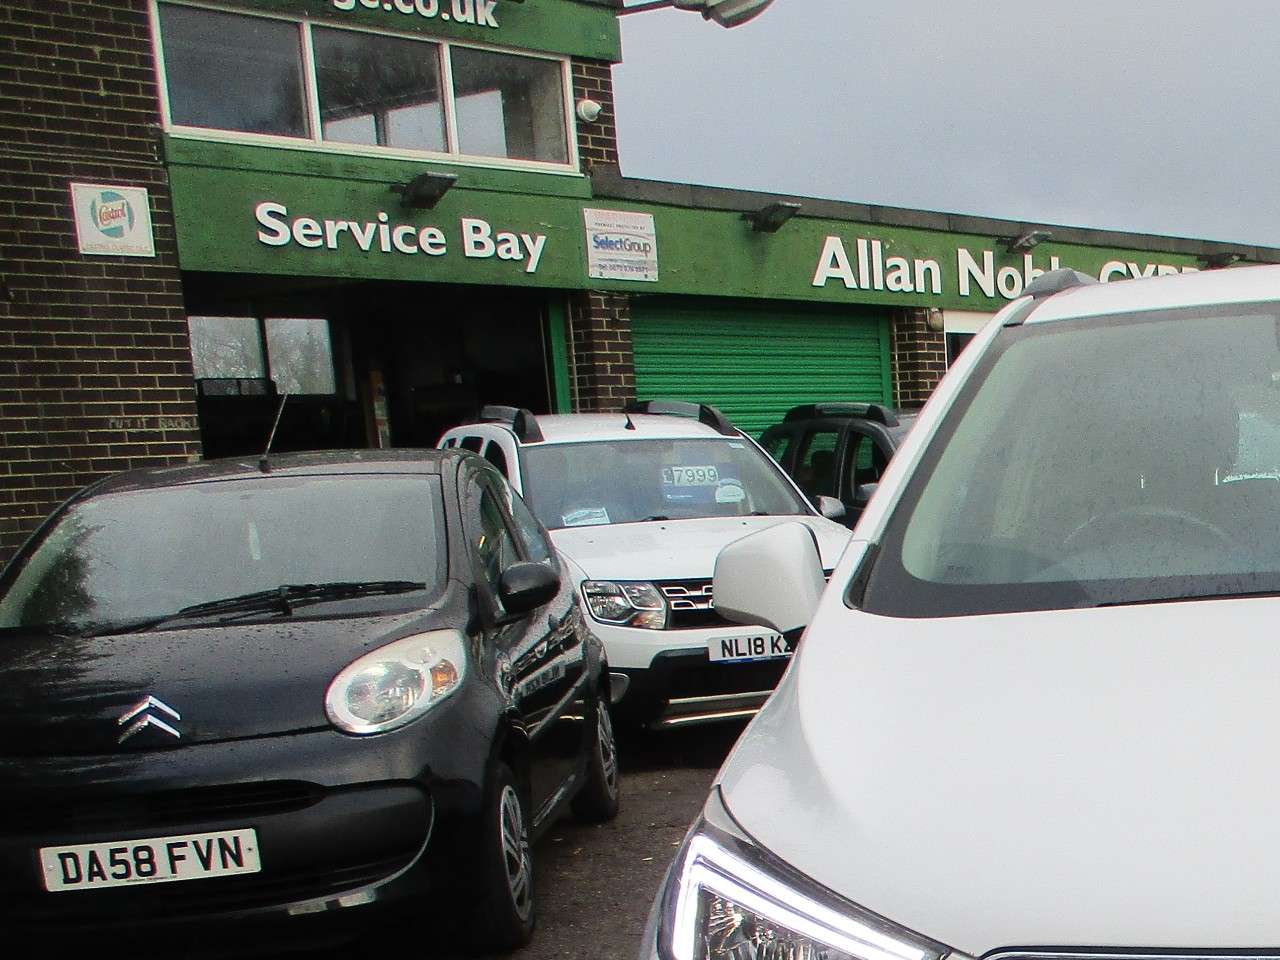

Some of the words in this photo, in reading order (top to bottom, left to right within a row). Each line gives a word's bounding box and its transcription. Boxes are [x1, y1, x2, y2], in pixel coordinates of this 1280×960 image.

[254, 202, 448, 257] Service
[461, 217, 547, 273] Bay
[593, 233, 652, 257] SelectGroup
[811, 236, 942, 294] Allan
[721, 637, 765, 657] NL18
[57, 845, 158, 884] DA58
[166, 836, 245, 874] FVN
